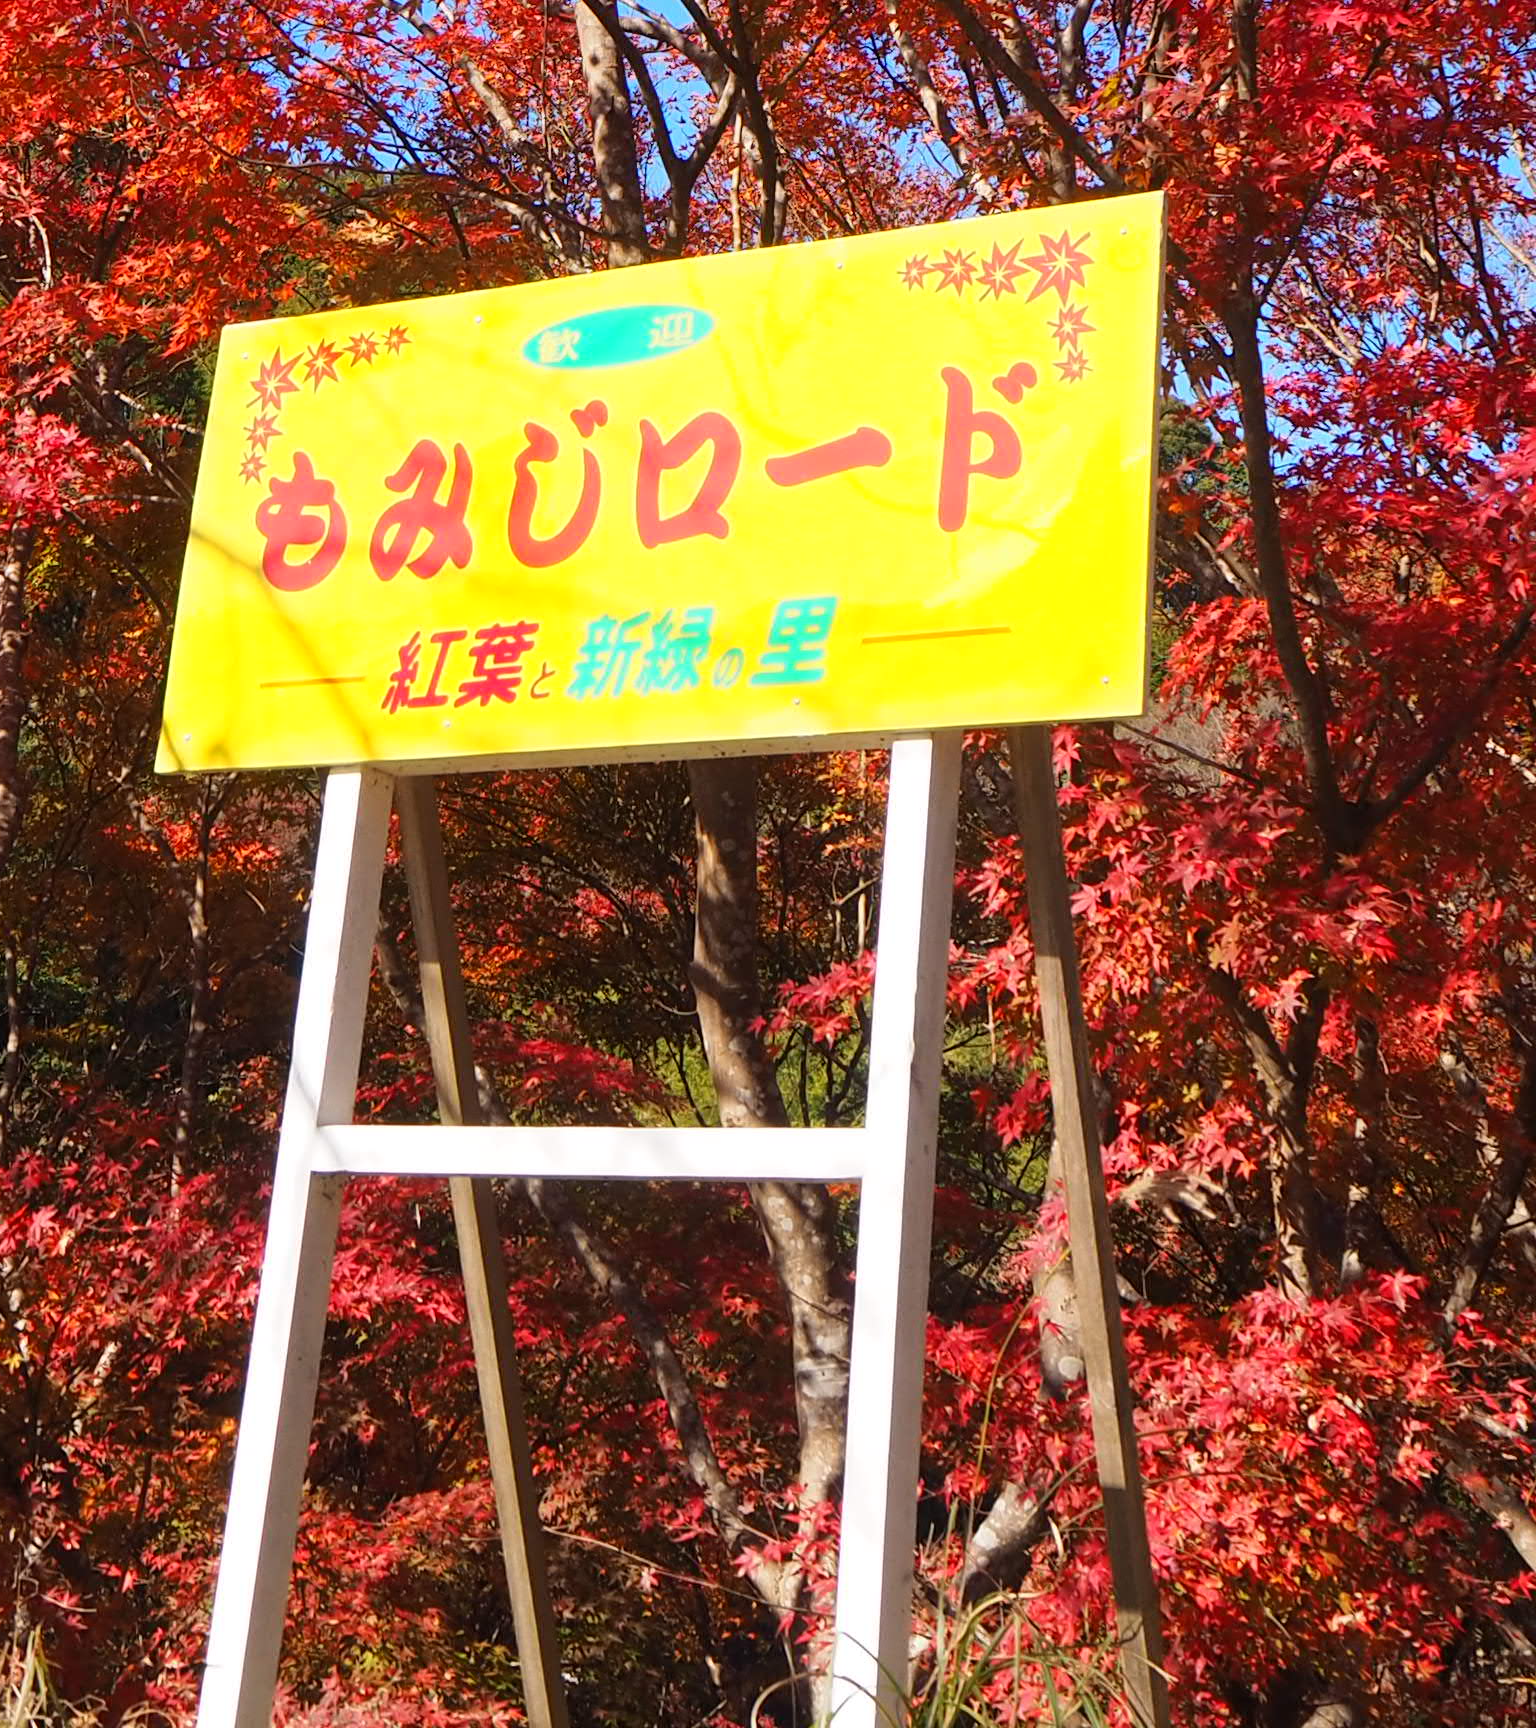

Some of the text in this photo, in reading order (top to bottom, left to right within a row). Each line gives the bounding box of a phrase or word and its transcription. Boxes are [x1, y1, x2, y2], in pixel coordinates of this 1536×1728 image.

[256, 362, 1038, 592] もみじロード
[382, 595, 838, 715] 紅葉と新緑の里
